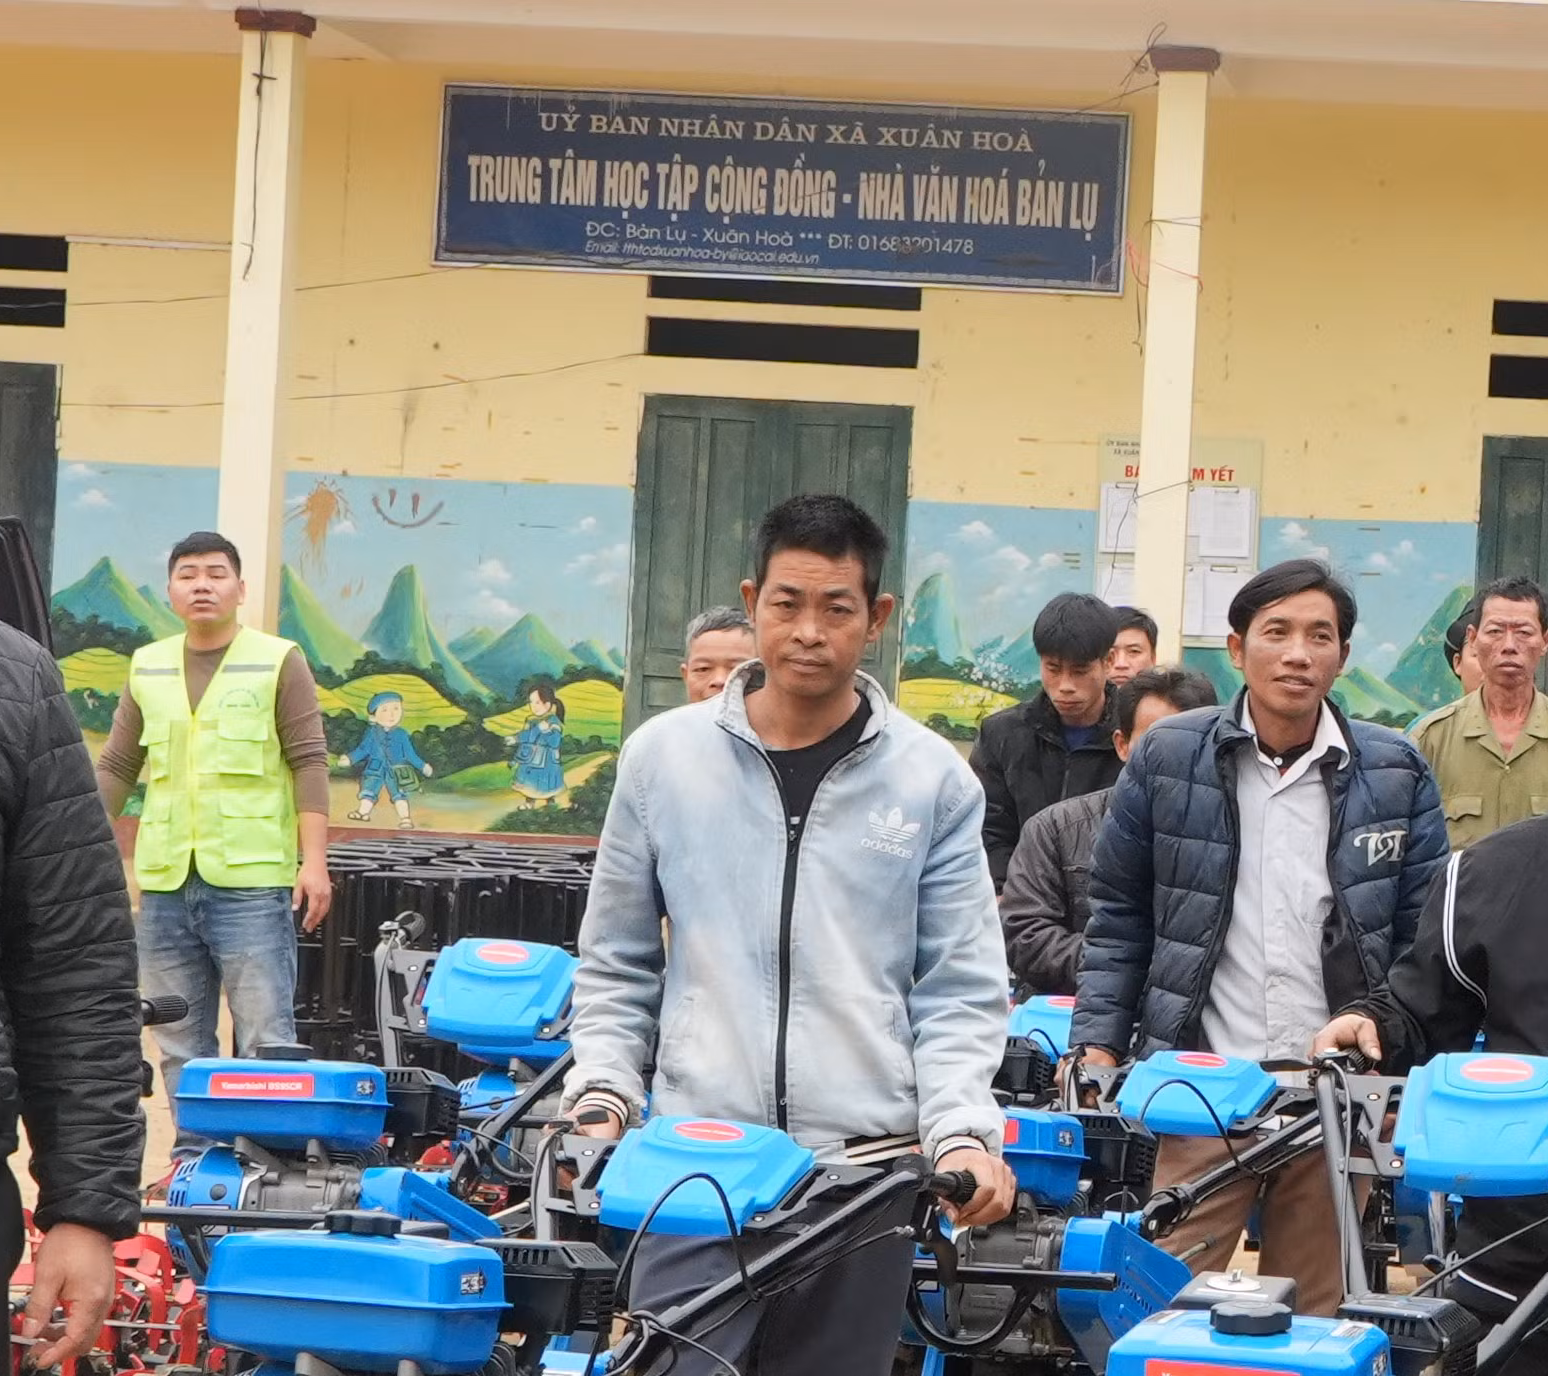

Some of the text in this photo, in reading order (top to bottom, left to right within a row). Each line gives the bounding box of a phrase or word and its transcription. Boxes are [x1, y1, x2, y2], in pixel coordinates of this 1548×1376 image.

[539, 104, 1034, 152] UỶ BAN NHÂN DÂN XÃ XUÂN HOÀ
[468, 154, 542, 204] TRUNG
[549, 148, 598, 207] TÂM
[603, 160, 650, 220] HỌC
[656, 153, 699, 222] TẬP
[705, 155, 768, 224] CỘNG
[773, 153, 837, 219] ĐỒNG
[858, 163, 905, 222] NHÀ
[912, 164, 959, 224] VĂN
[964, 168, 1009, 226] HOÁ
[1016, 159, 1064, 228] BẢN
[1069, 182, 1099, 242] LỤ
[585, 221, 621, 238] ĐC:
[626, 224, 661, 240] Bản
[666, 227, 686, 245] Lụ
[702, 227, 750, 245] Xuân
[755, 230, 793, 247] Hoà
